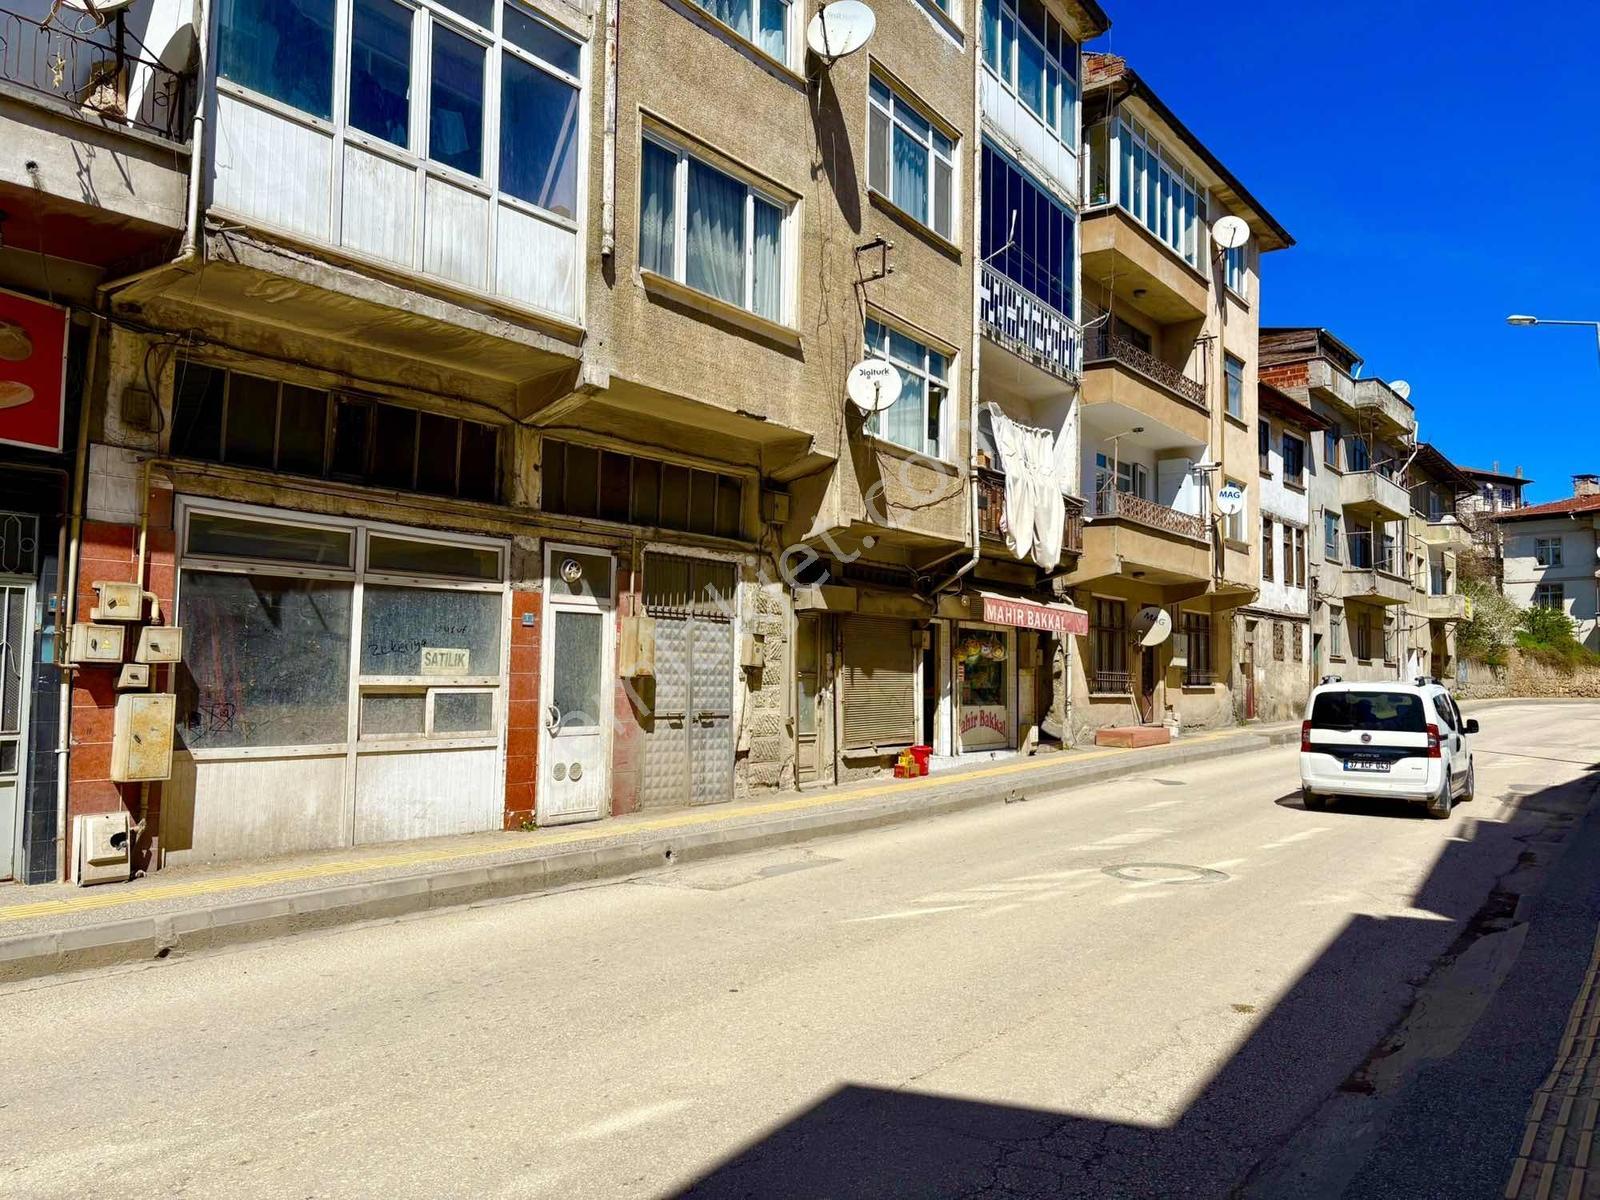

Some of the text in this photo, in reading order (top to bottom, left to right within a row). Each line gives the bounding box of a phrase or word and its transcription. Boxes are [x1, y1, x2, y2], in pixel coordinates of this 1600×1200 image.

[1219, 490, 1240, 499] MAG
[1027, 611, 1066, 631] BAKKAL
[1144, 611, 1166, 626] MAG
[424, 651, 466, 667] SATILIK
[960, 711, 978, 735] ahir
